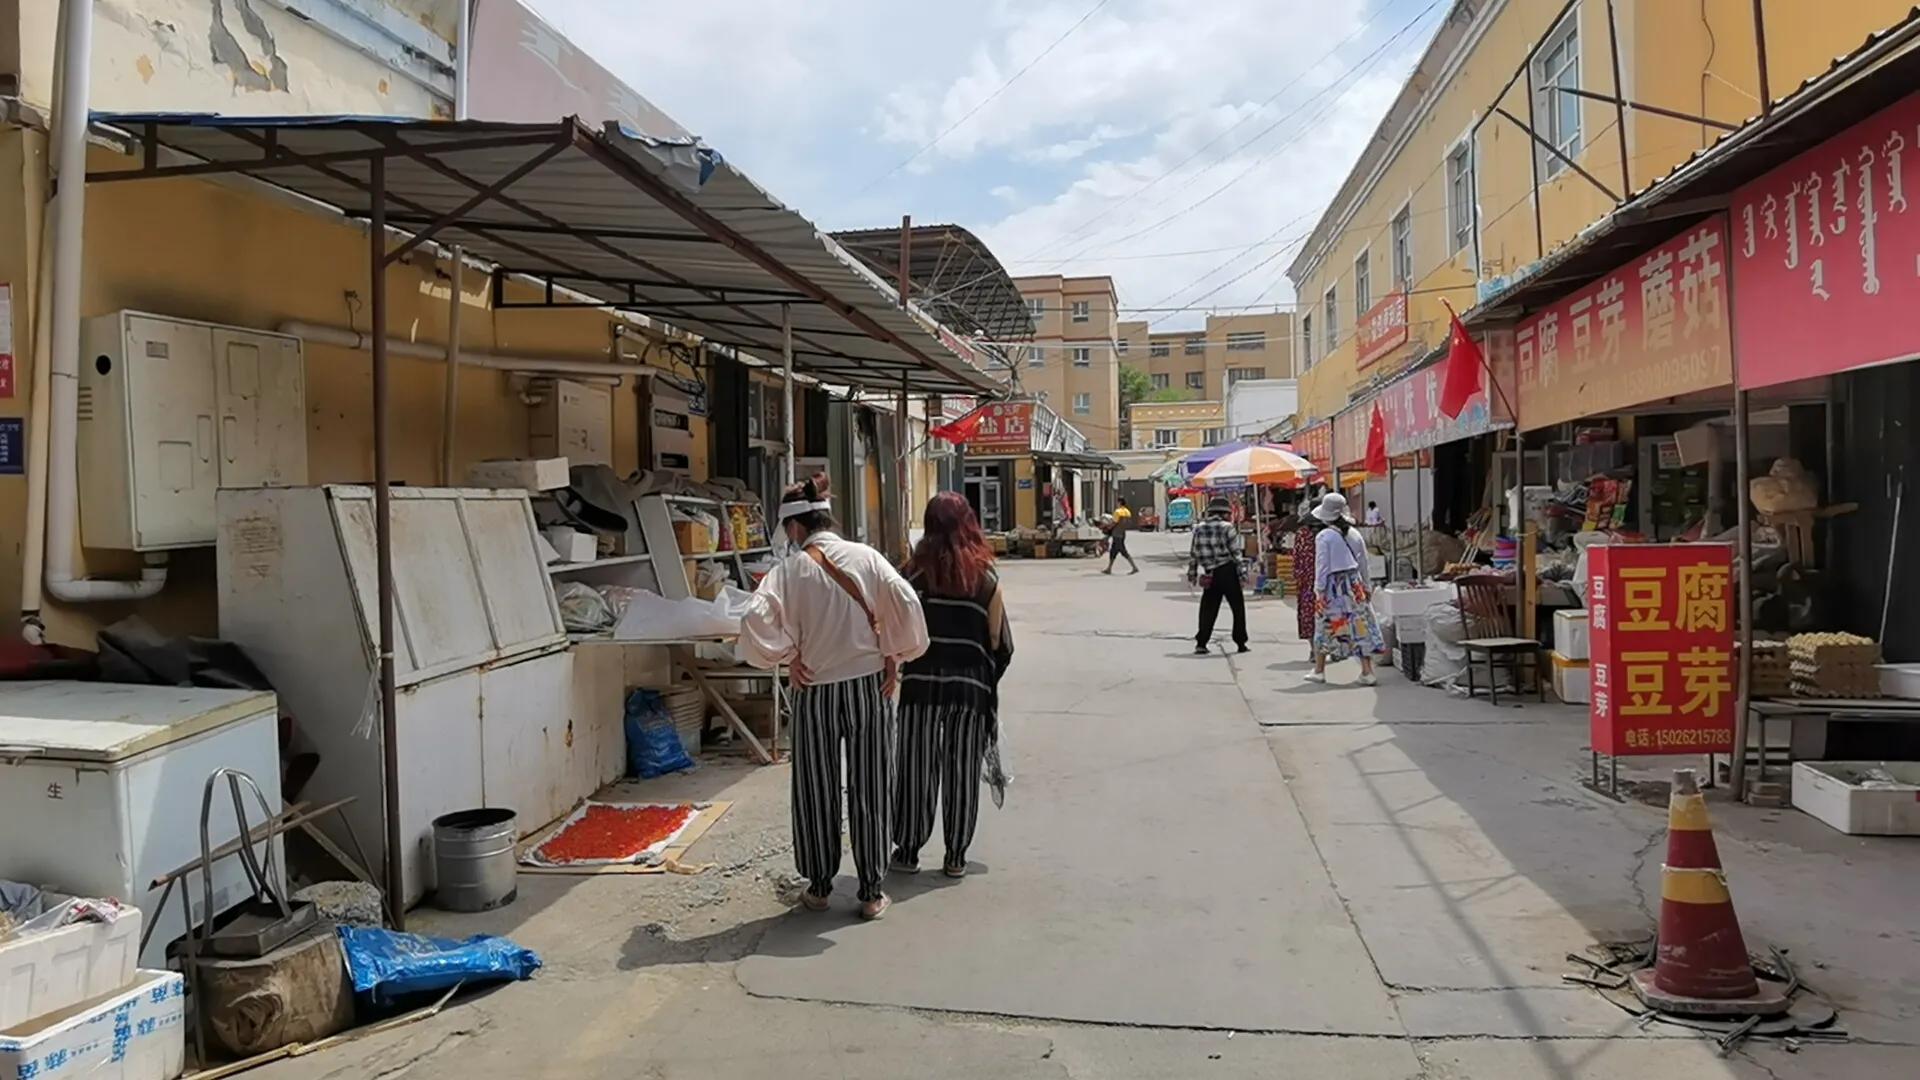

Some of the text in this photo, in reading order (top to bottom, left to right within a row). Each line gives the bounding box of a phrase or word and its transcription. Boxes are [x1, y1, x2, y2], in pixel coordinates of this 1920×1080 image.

[1516, 228, 1722, 390] 豆腐 豆芽 蘑菇
[1592, 575, 1606, 630] 豆腐
[1617, 562, 1729, 633] 豆腐
[1618, 646, 1731, 718] 豆芽
[47, 782, 64, 800] 生
